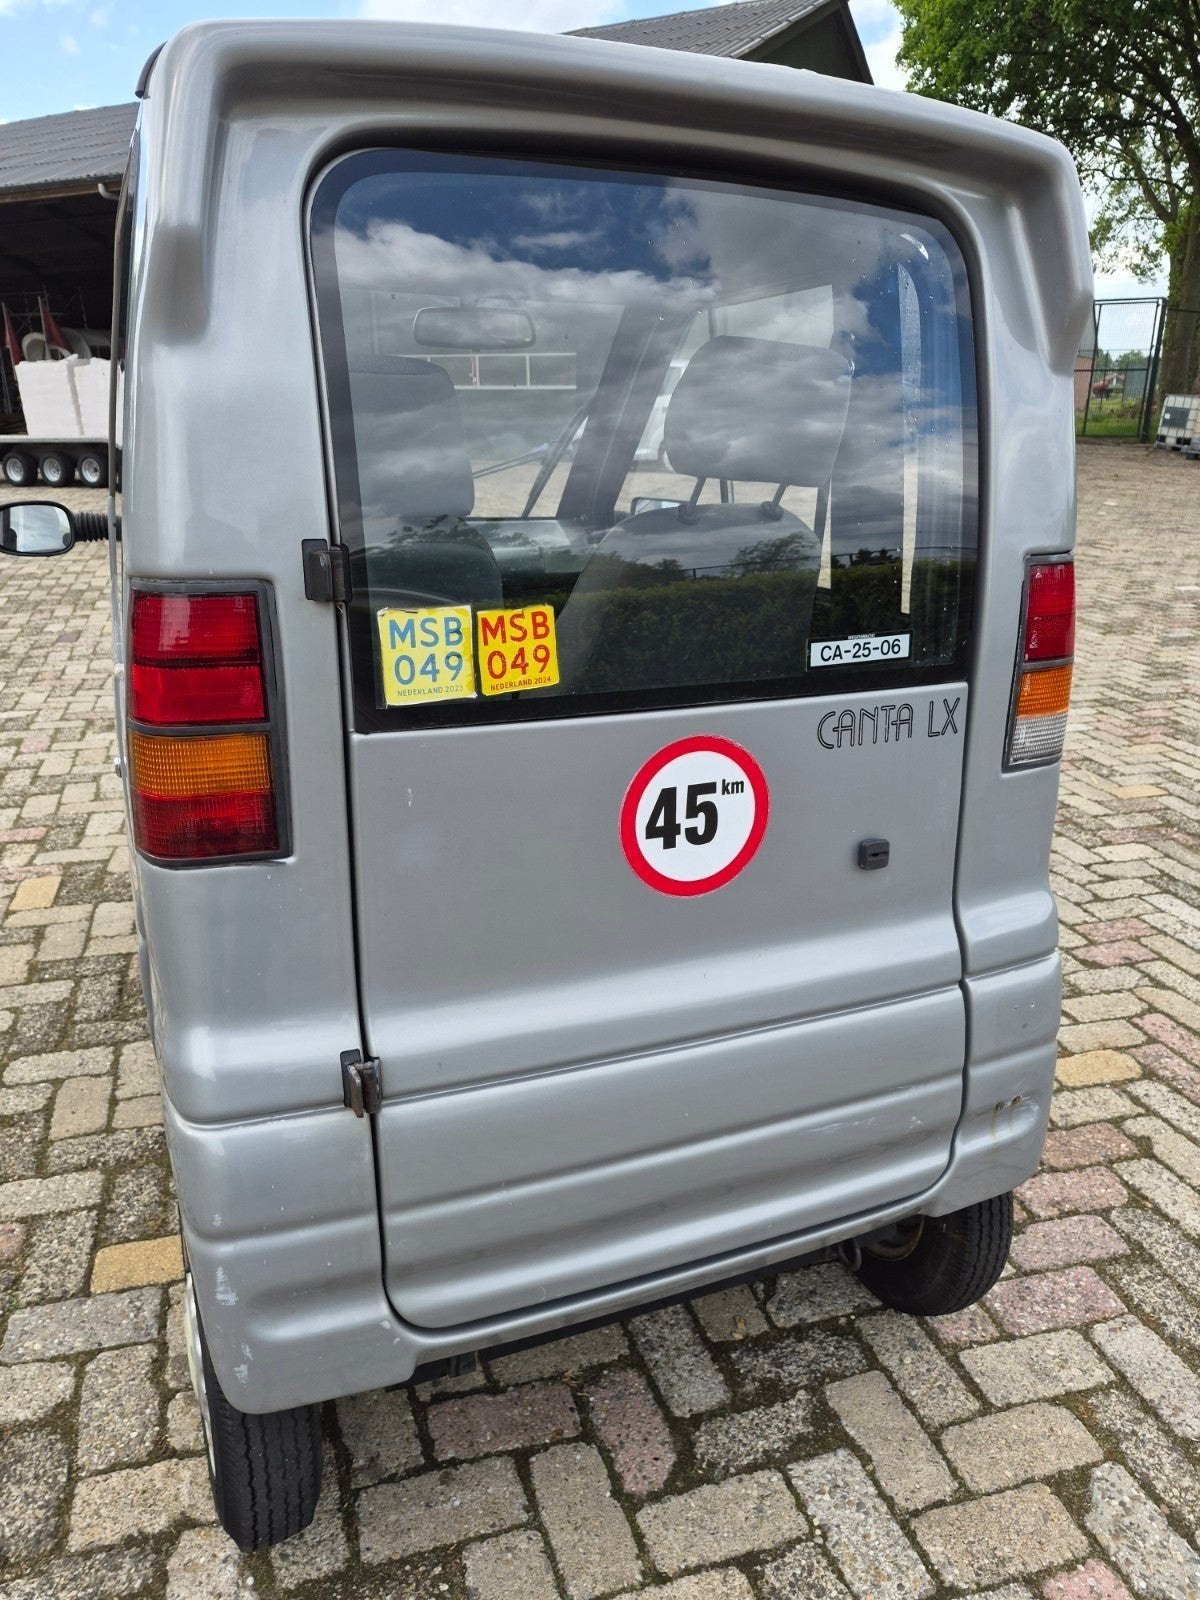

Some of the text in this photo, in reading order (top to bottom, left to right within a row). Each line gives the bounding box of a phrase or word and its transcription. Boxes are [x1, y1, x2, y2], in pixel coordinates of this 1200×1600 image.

[389, 617, 463, 649] MSB
[480, 611, 550, 646] MSB
[487, 645, 550, 679] 049
[820, 639, 901, 662] CA-25-06
[395, 652, 463, 685] 049
[490, 676, 552, 691] NEDERLAND 2024
[397, 685, 464, 697] NEDERLAND 2023
[817, 697, 960, 749] CANTA LX
[645, 778, 744, 850] 45 km
